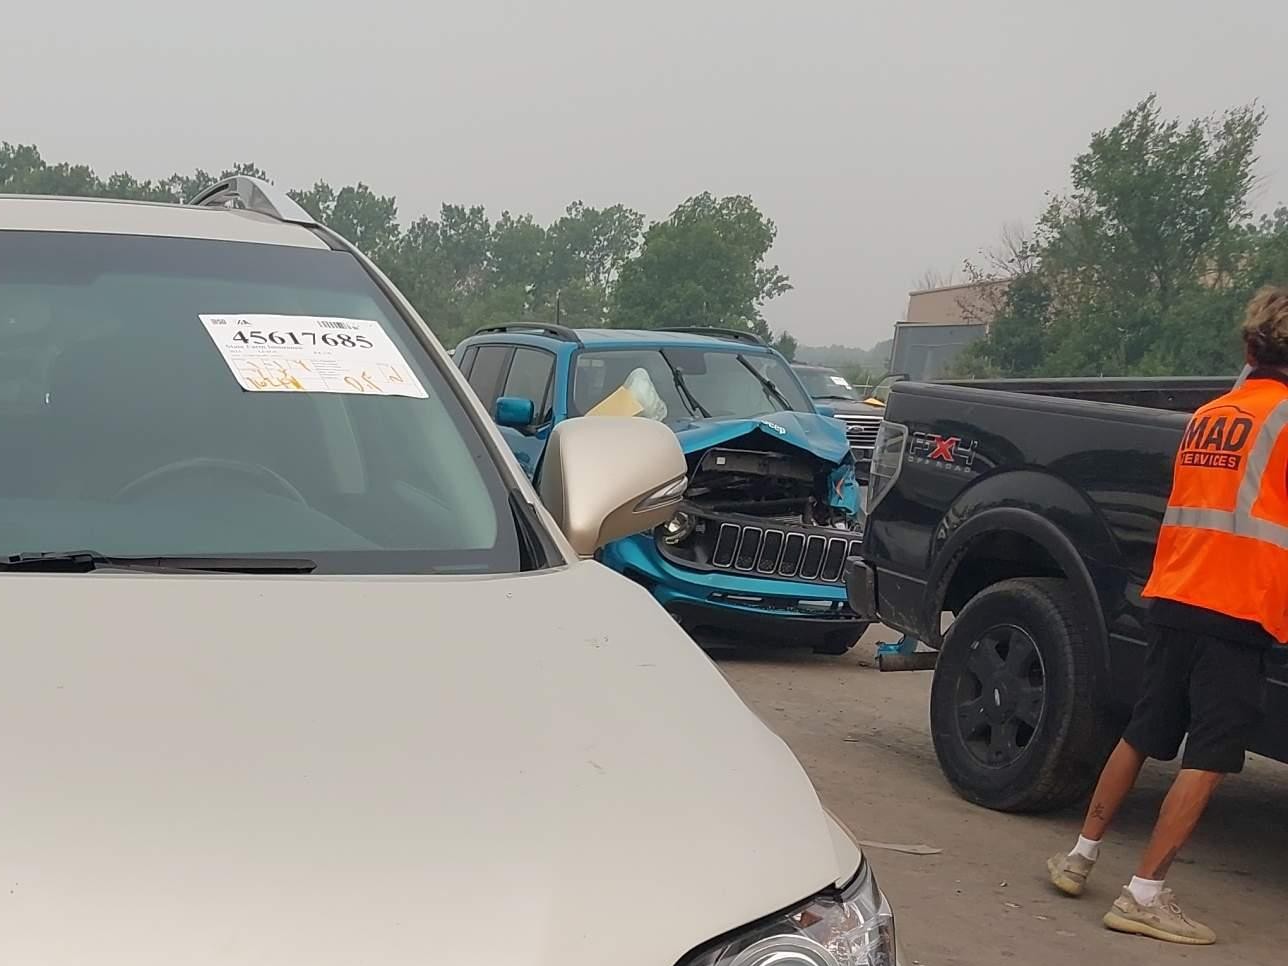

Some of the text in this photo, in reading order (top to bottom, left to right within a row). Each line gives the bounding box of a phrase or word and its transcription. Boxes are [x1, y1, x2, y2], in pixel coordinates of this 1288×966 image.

[232, 330, 374, 349] 45617685
[909, 431, 979, 466] FX4
[1181, 416, 1253, 452] MAD
